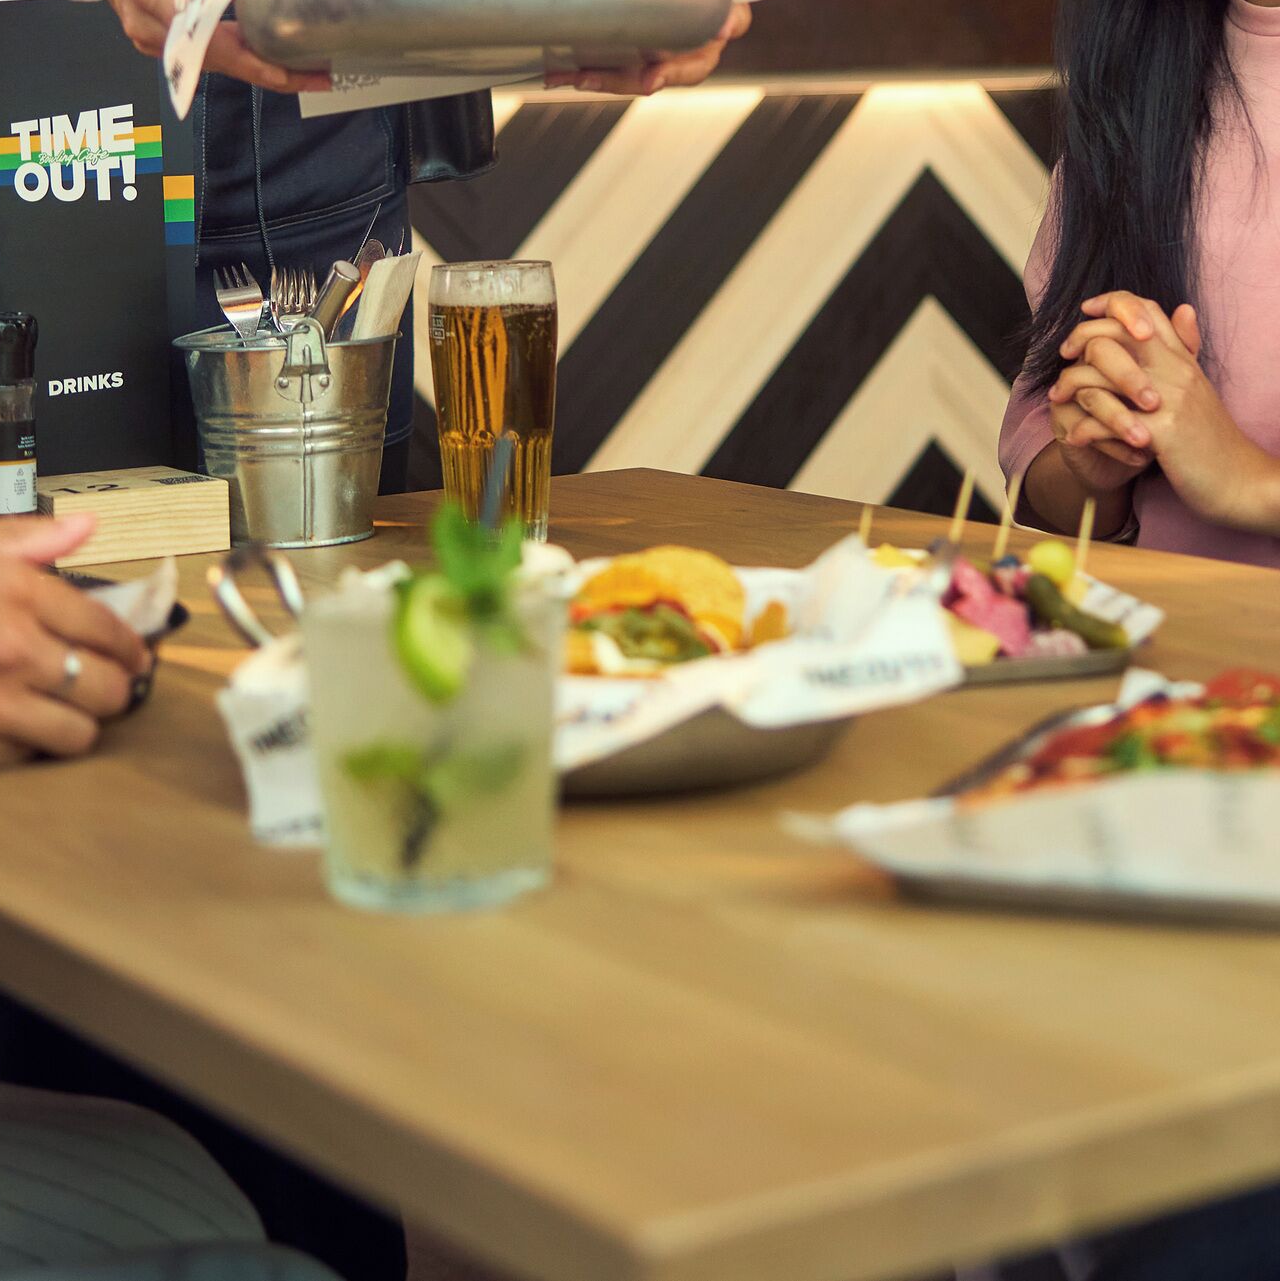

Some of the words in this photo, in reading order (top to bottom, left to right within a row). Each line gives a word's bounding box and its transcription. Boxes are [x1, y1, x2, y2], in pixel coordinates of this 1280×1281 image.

[10, 103, 135, 161] TIME
[38, 150, 75, 167] Bowling
[14, 154, 138, 202] OUT!
[48, 371, 124, 396] DRINKS
[50, 483, 129, 494] 12
